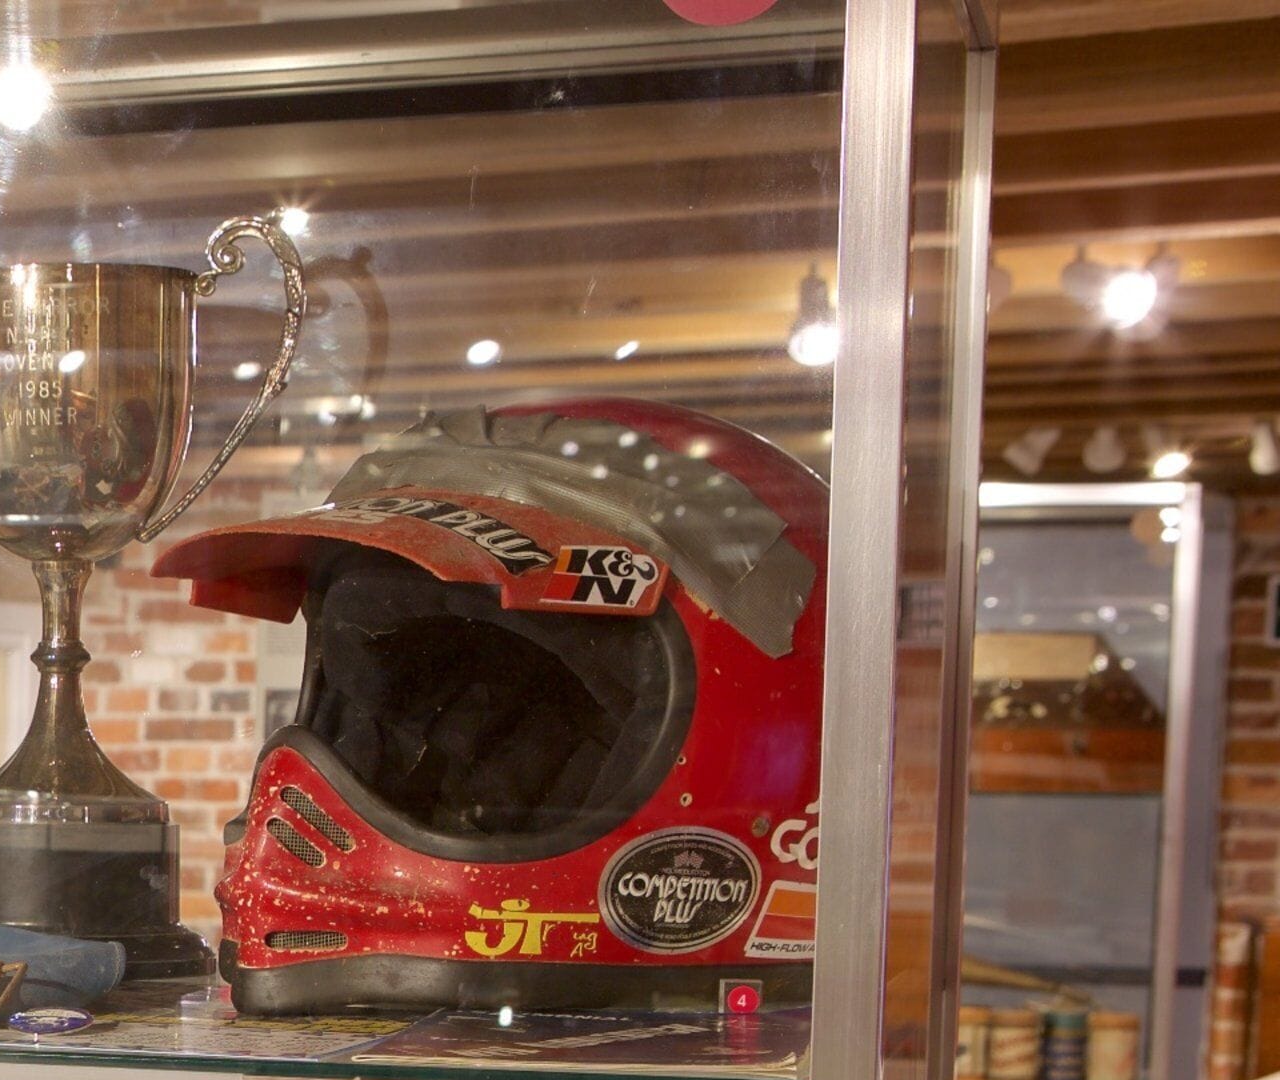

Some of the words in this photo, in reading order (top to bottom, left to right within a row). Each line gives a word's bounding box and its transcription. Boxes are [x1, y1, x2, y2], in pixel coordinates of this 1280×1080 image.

[19, 380, 63, 399] 1985
[4, 407, 78, 426] WINNER
[567, 548, 656, 606] K&N
[617, 871, 748, 903] COMPETITION
[653, 899, 704, 923] PLUS
[736, 994, 747, 1007] 4
